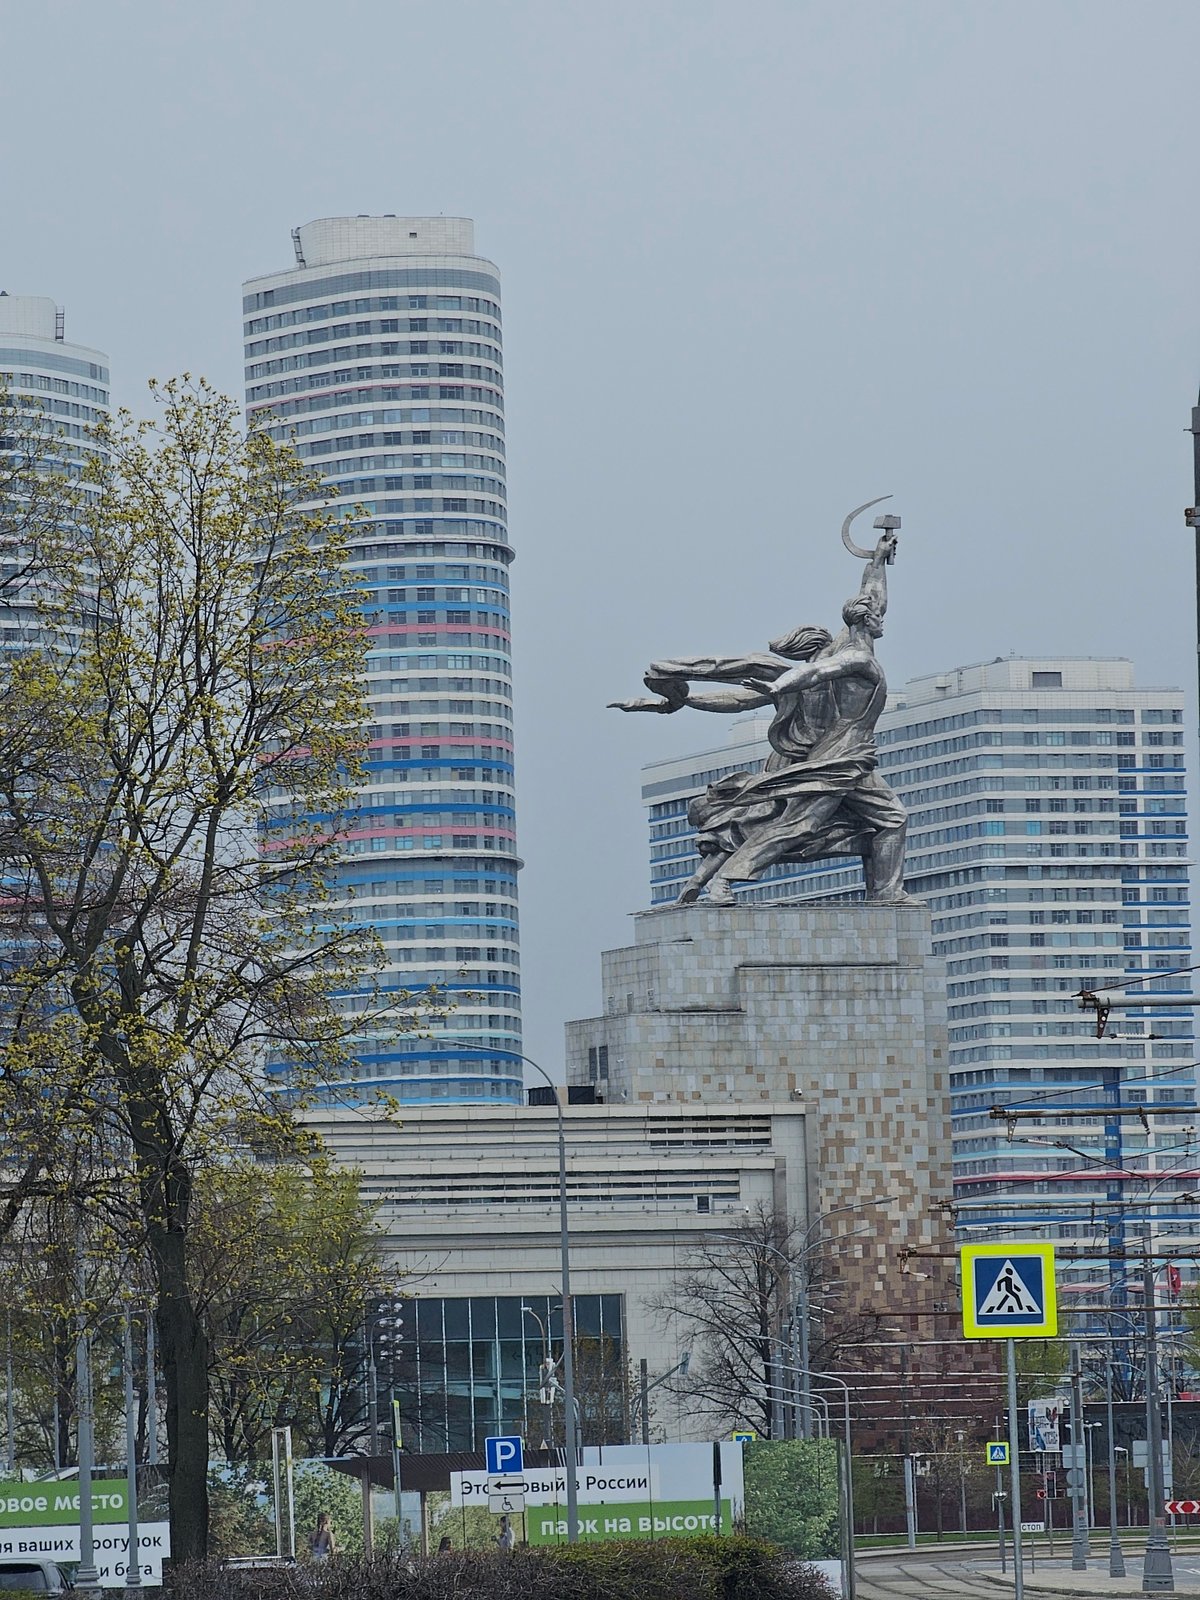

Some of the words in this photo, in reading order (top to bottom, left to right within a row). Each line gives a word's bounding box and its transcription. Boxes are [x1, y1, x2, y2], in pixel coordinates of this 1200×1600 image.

[496, 1441, 516, 1470] P
[461, 1481, 489, 1494] Это
[586, 1475, 648, 1491] России
[53, 1493, 124, 1511] место
[604, 1517, 631, 1533] на
[638, 1513, 723, 1532] высоте
[18, 1539, 74, 1553] ваших
[99, 1566, 109, 1577] и
